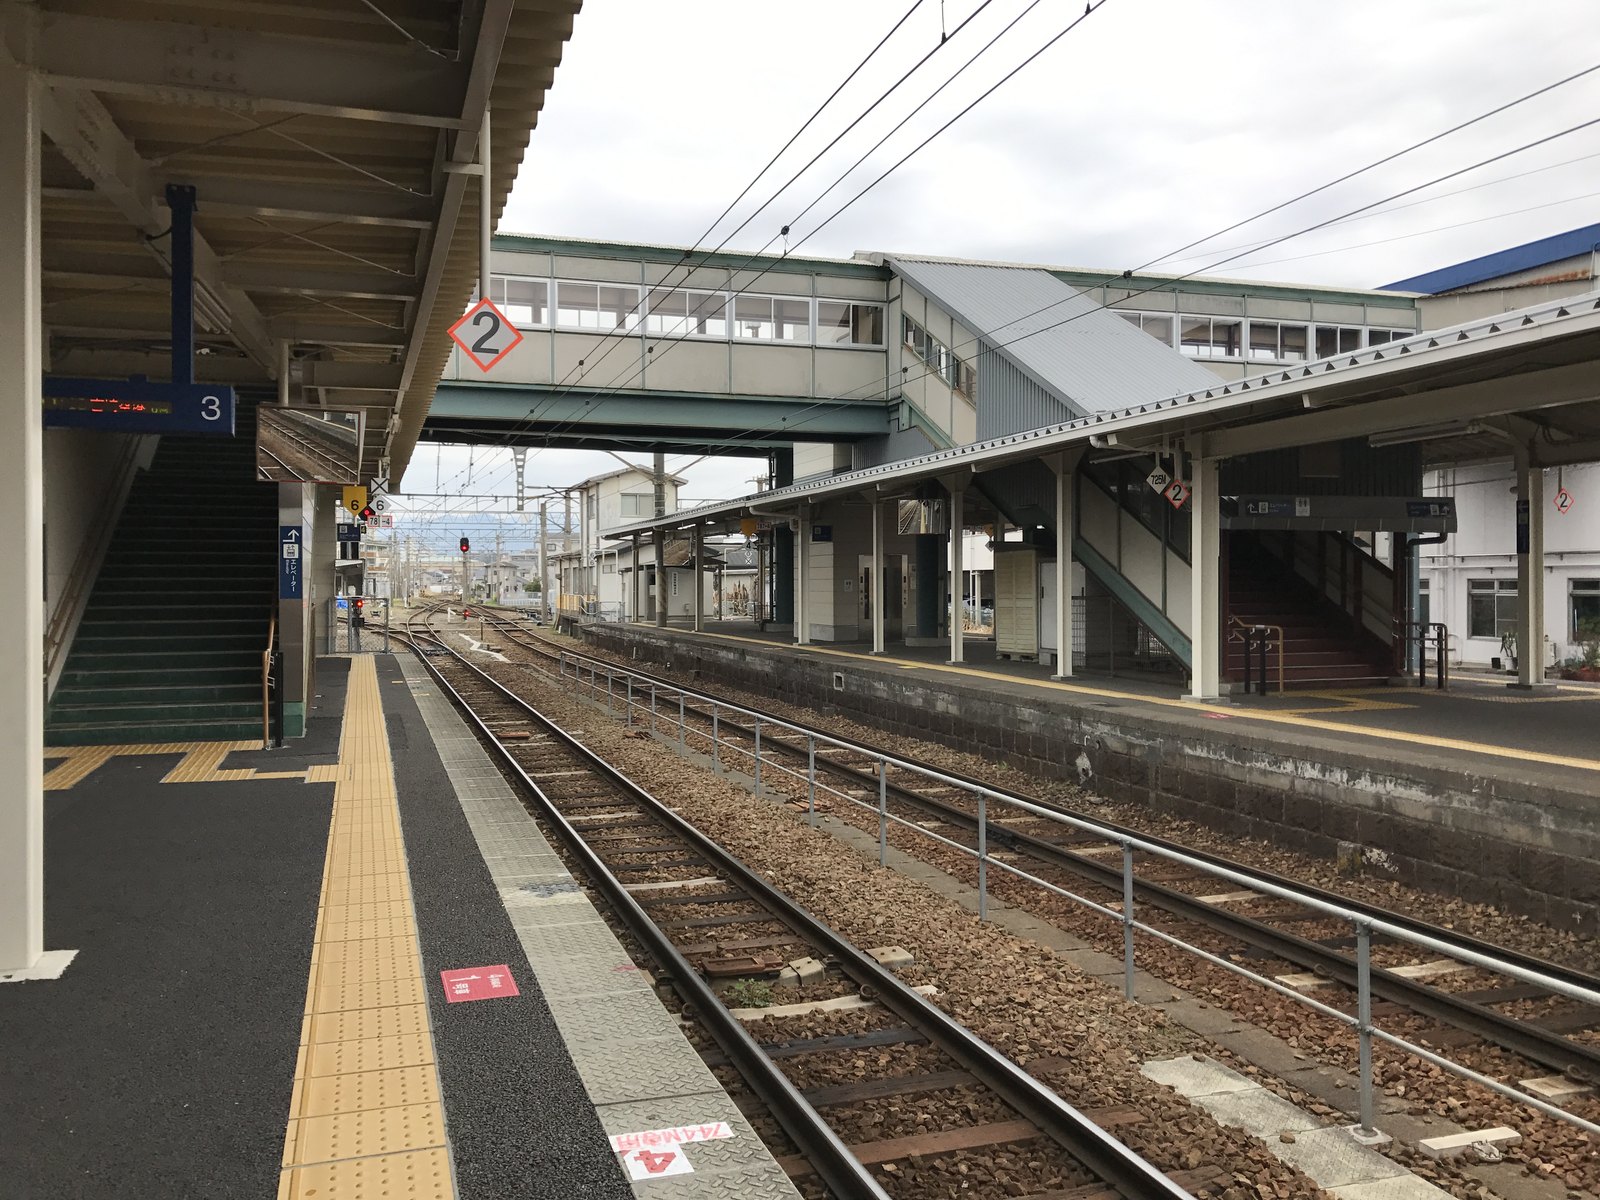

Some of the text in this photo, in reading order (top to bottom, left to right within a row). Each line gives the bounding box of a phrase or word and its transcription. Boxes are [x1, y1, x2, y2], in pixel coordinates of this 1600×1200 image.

[471, 311, 500, 355] 2
[200, 395, 221, 421] 3
[1172, 484, 1182, 501] 2
[1559, 493, 1568, 508] 2
[351, 499, 359, 511] 6
[376, 500, 384, 511] 6
[633, 1150, 677, 1174] 4
